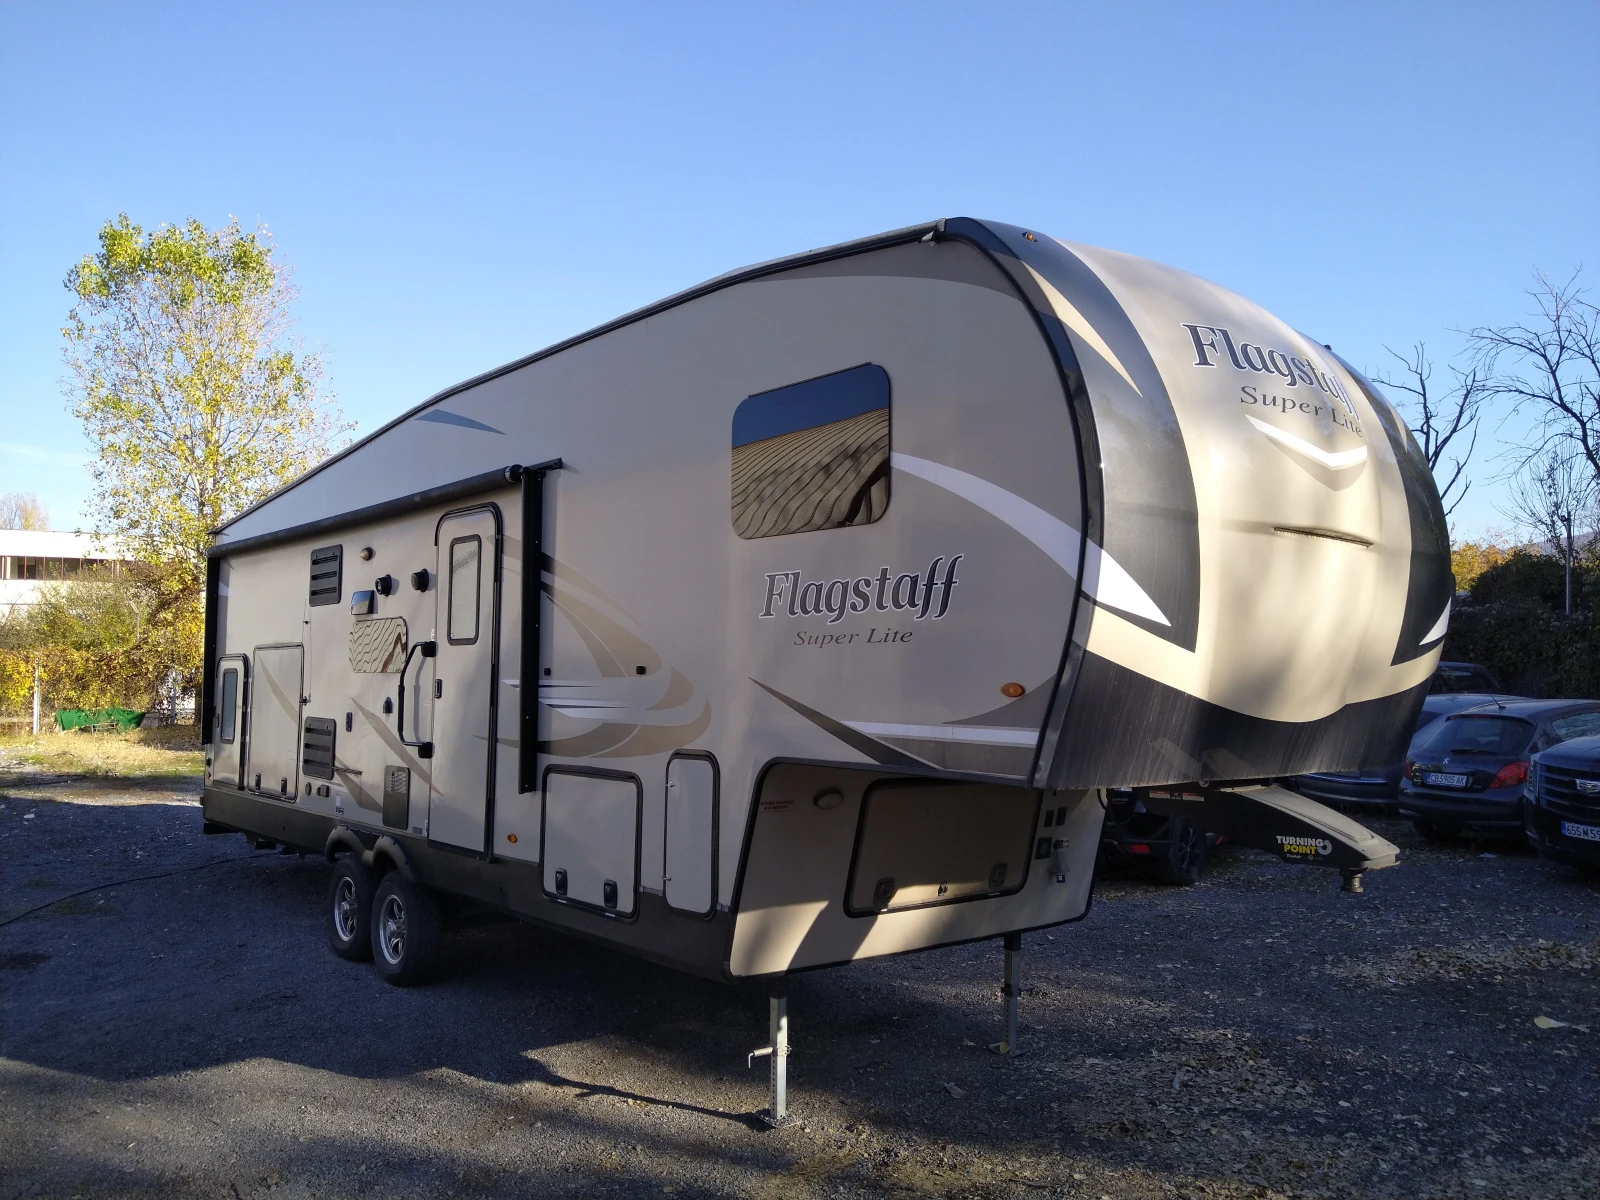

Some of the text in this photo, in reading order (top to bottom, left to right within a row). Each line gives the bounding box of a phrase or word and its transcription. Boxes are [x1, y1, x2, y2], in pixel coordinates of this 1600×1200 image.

[1240, 385, 1363, 437] Super Lite
[759, 553, 964, 625] Flagstaff
[794, 627, 913, 648] Super Lite
[1456, 777, 1465, 785] AK
[1567, 825, 1581, 836] 655
[1583, 827, 1589, 838] M
[1276, 836, 1324, 847] TURNING
[1283, 844, 1317, 854] POINT
